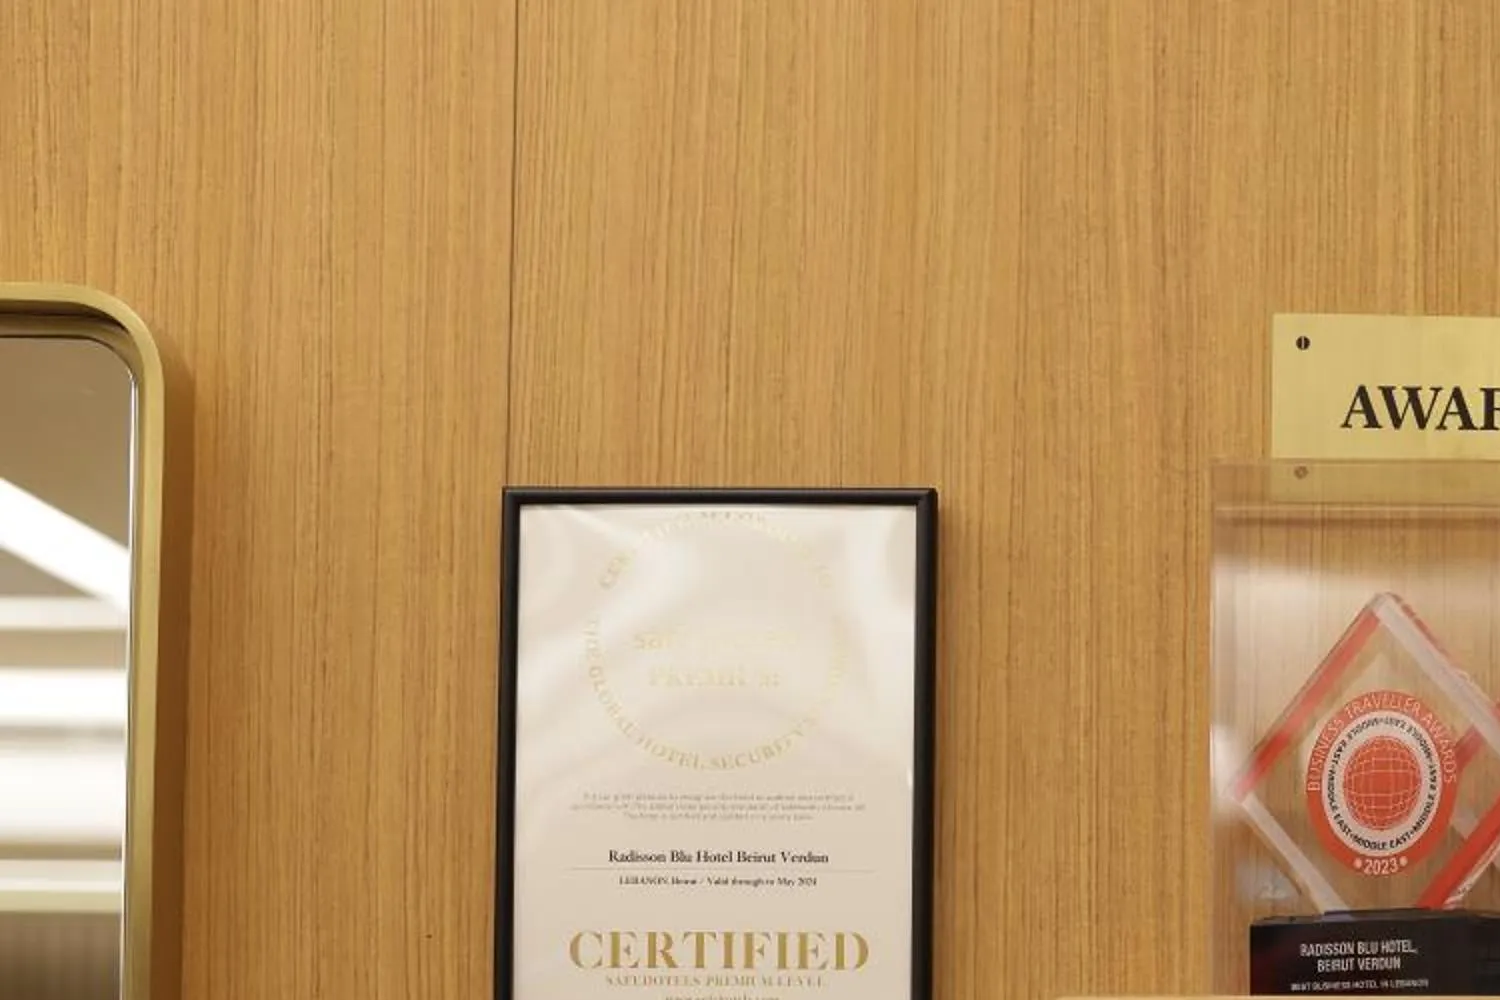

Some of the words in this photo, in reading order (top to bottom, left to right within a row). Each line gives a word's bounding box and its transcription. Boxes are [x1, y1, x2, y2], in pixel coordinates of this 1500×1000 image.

[1345, 693, 1421, 719] TRAVELLER
[1422, 713, 1457, 784] AWARDS
[609, 849, 667, 863] Radisson
[671, 849, 692, 863] Blu
[696, 849, 733, 863] Hotel
[737, 850, 777, 863] Beirut
[780, 850, 829, 863] Verdun
[1364, 856, 1399, 875] 2023
[569, 929, 870, 971] CERTIFIED
[1300, 942, 1354, 957] RADISSON
[1357, 941, 1379, 955] BLU
[1318, 958, 1354, 973] BEIRUT
[1358, 956, 1401, 972] VERDUN
